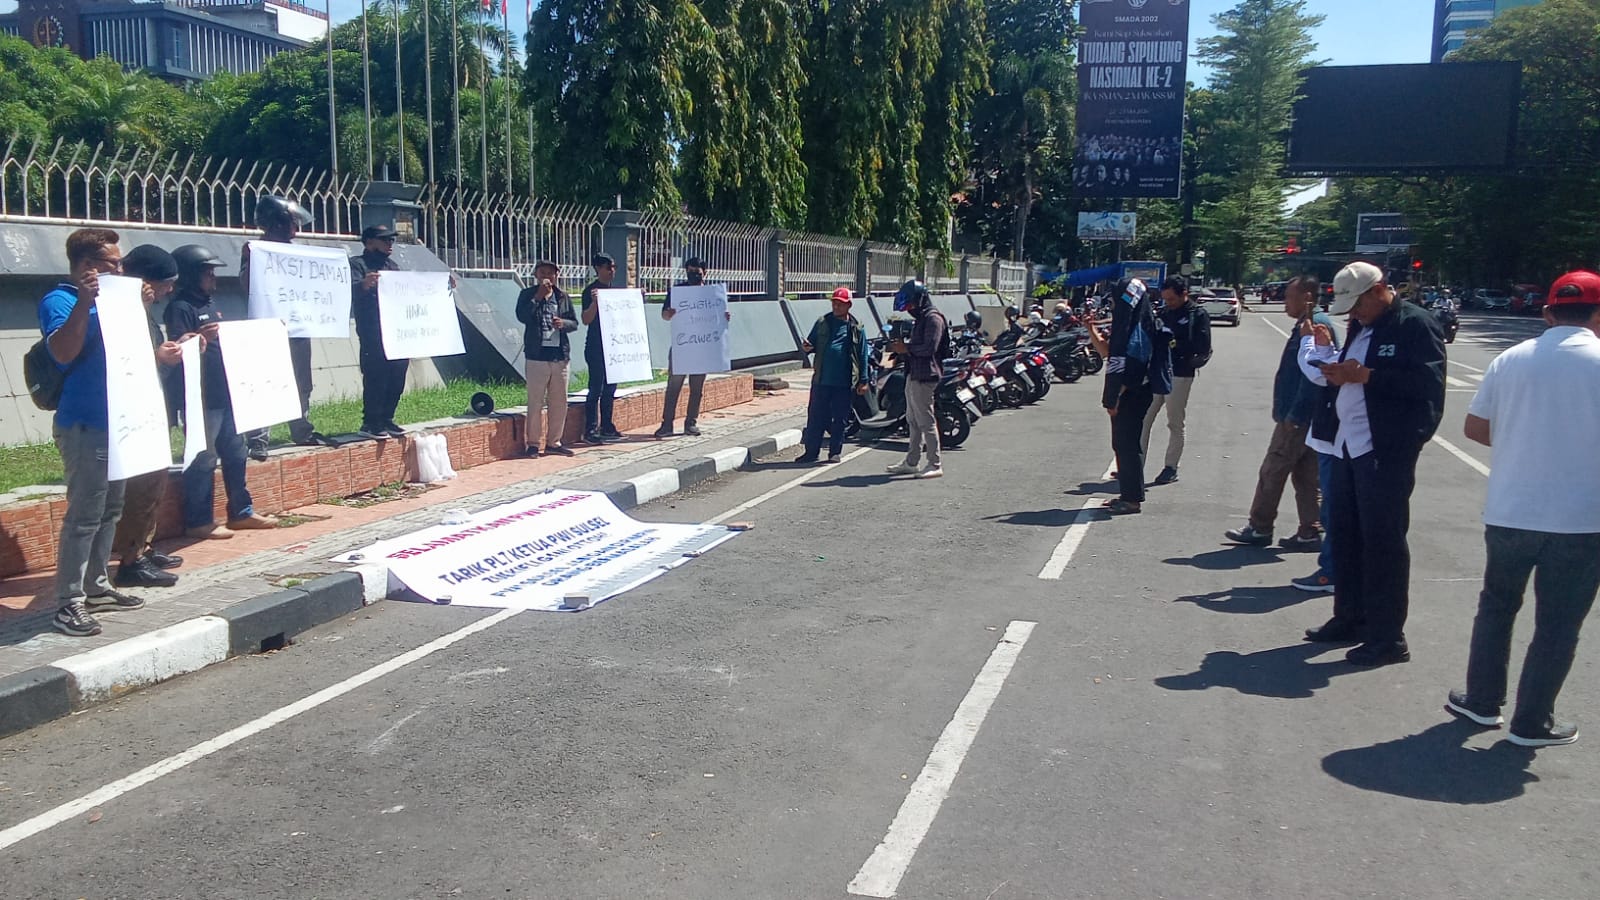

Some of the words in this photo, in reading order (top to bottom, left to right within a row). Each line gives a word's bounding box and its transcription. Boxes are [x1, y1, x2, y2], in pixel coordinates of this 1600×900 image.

[1141, 15, 1159, 23] 2002
[1083, 41, 1126, 64] TUDANG
[1128, 40, 1183, 63] SIPULUNG
[1089, 66, 1143, 89] NASIONAL
[1145, 65, 1173, 88] KE-2
[1377, 344, 1395, 356] 23
[438, 562, 491, 586] TARIK
[507, 538, 554, 560] KETUA
[546, 529, 577, 545] PWI
[569, 516, 611, 536] SULSEL
